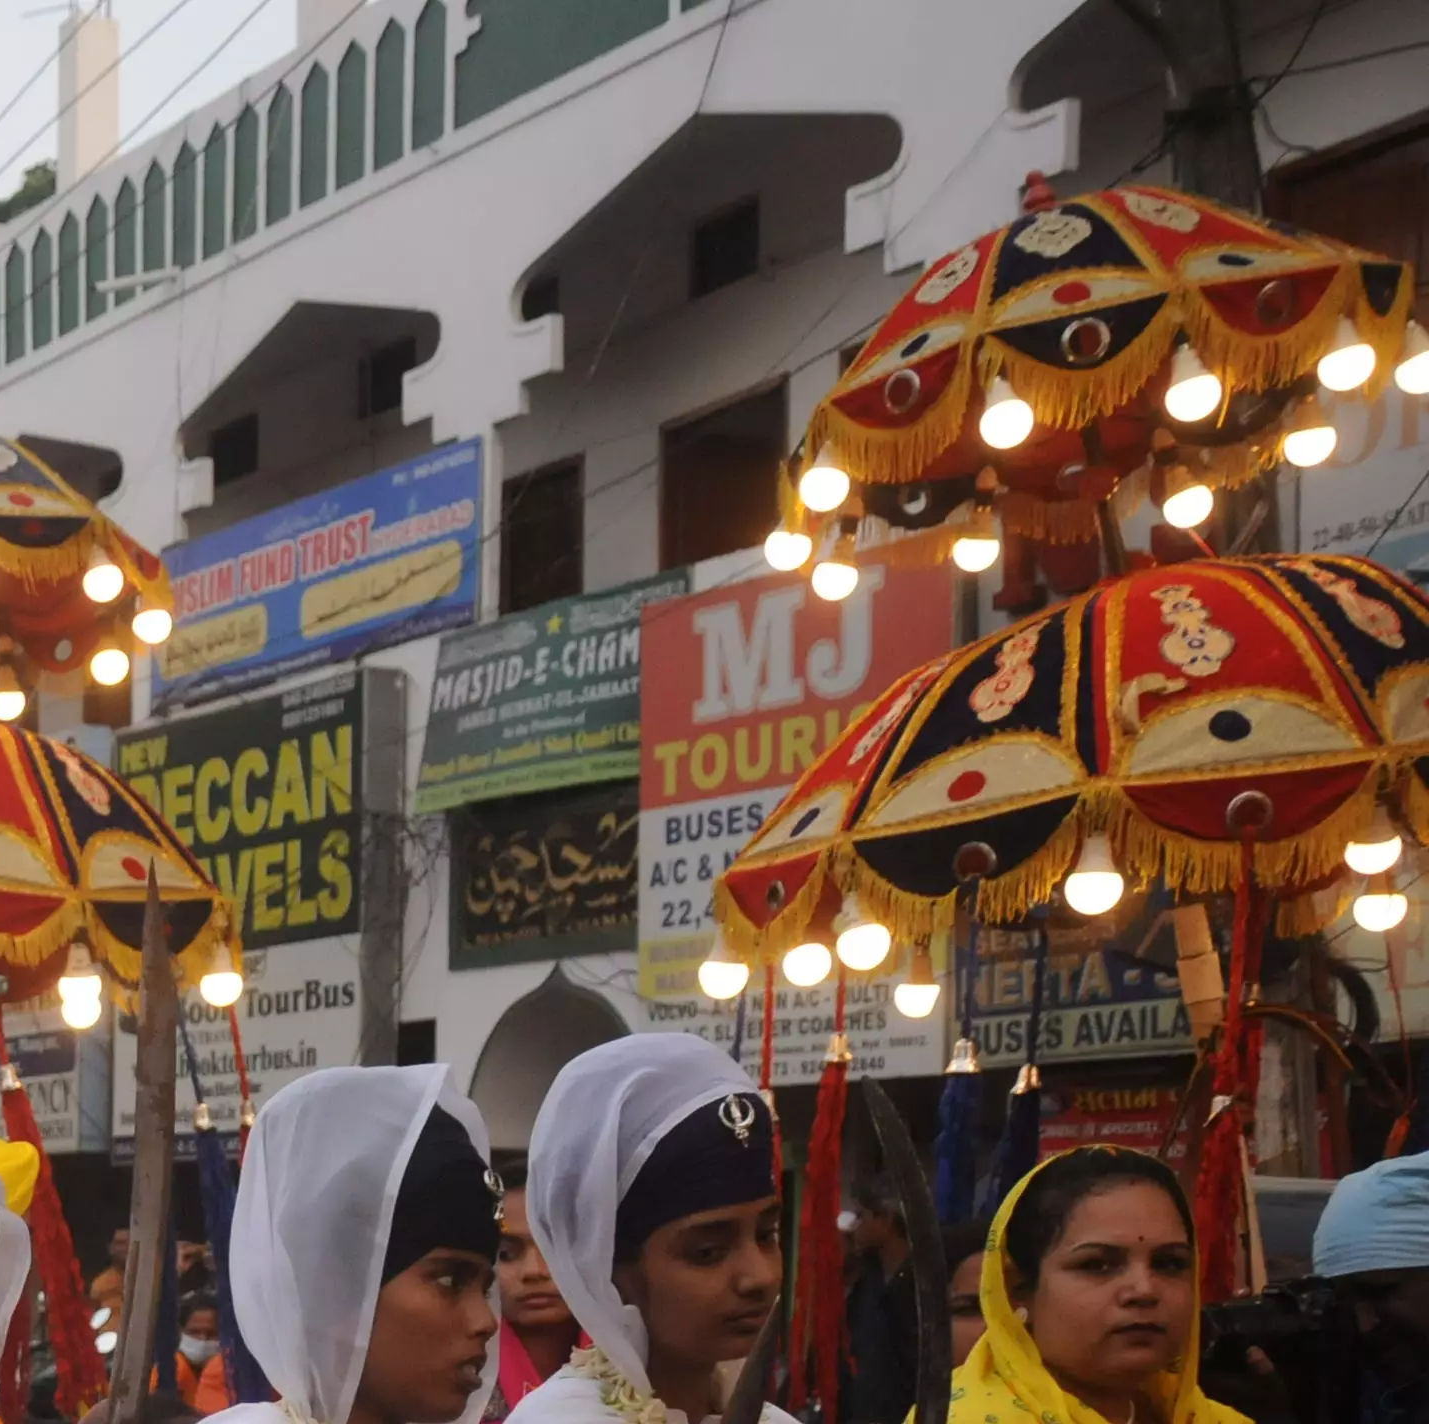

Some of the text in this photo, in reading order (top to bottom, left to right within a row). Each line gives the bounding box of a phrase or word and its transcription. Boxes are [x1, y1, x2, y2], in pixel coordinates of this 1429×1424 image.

[171, 561, 235, 620] USLIM
[238, 541, 296, 598] FUND
[298, 510, 376, 577] TRUST
[120, 735, 168, 774] NEW
[664, 801, 764, 846] BUSES
[649, 857, 688, 888] A/C
[697, 852, 713, 879] &
[246, 978, 355, 1019] TourBus
